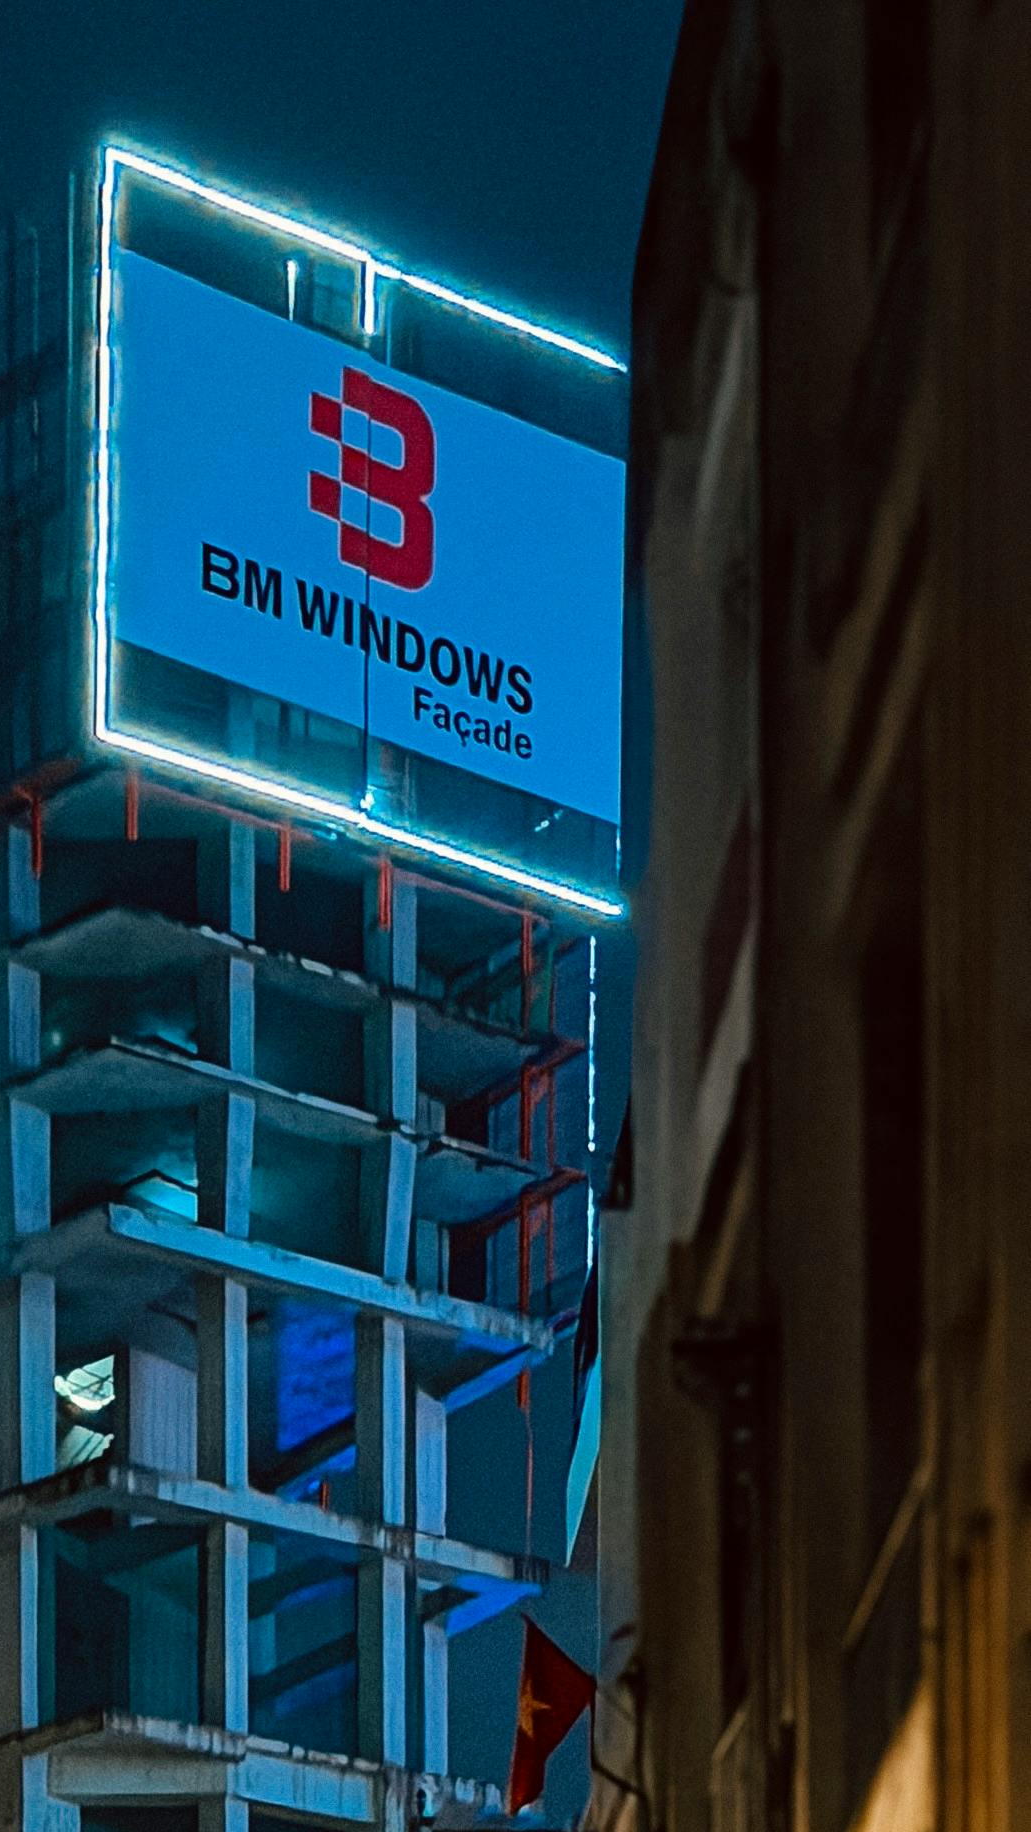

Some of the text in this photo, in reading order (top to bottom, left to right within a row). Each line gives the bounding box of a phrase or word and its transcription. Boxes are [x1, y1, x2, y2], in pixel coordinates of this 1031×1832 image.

[200, 540, 534, 714] BM WINDOWS
[412, 684, 534, 760] Façade
